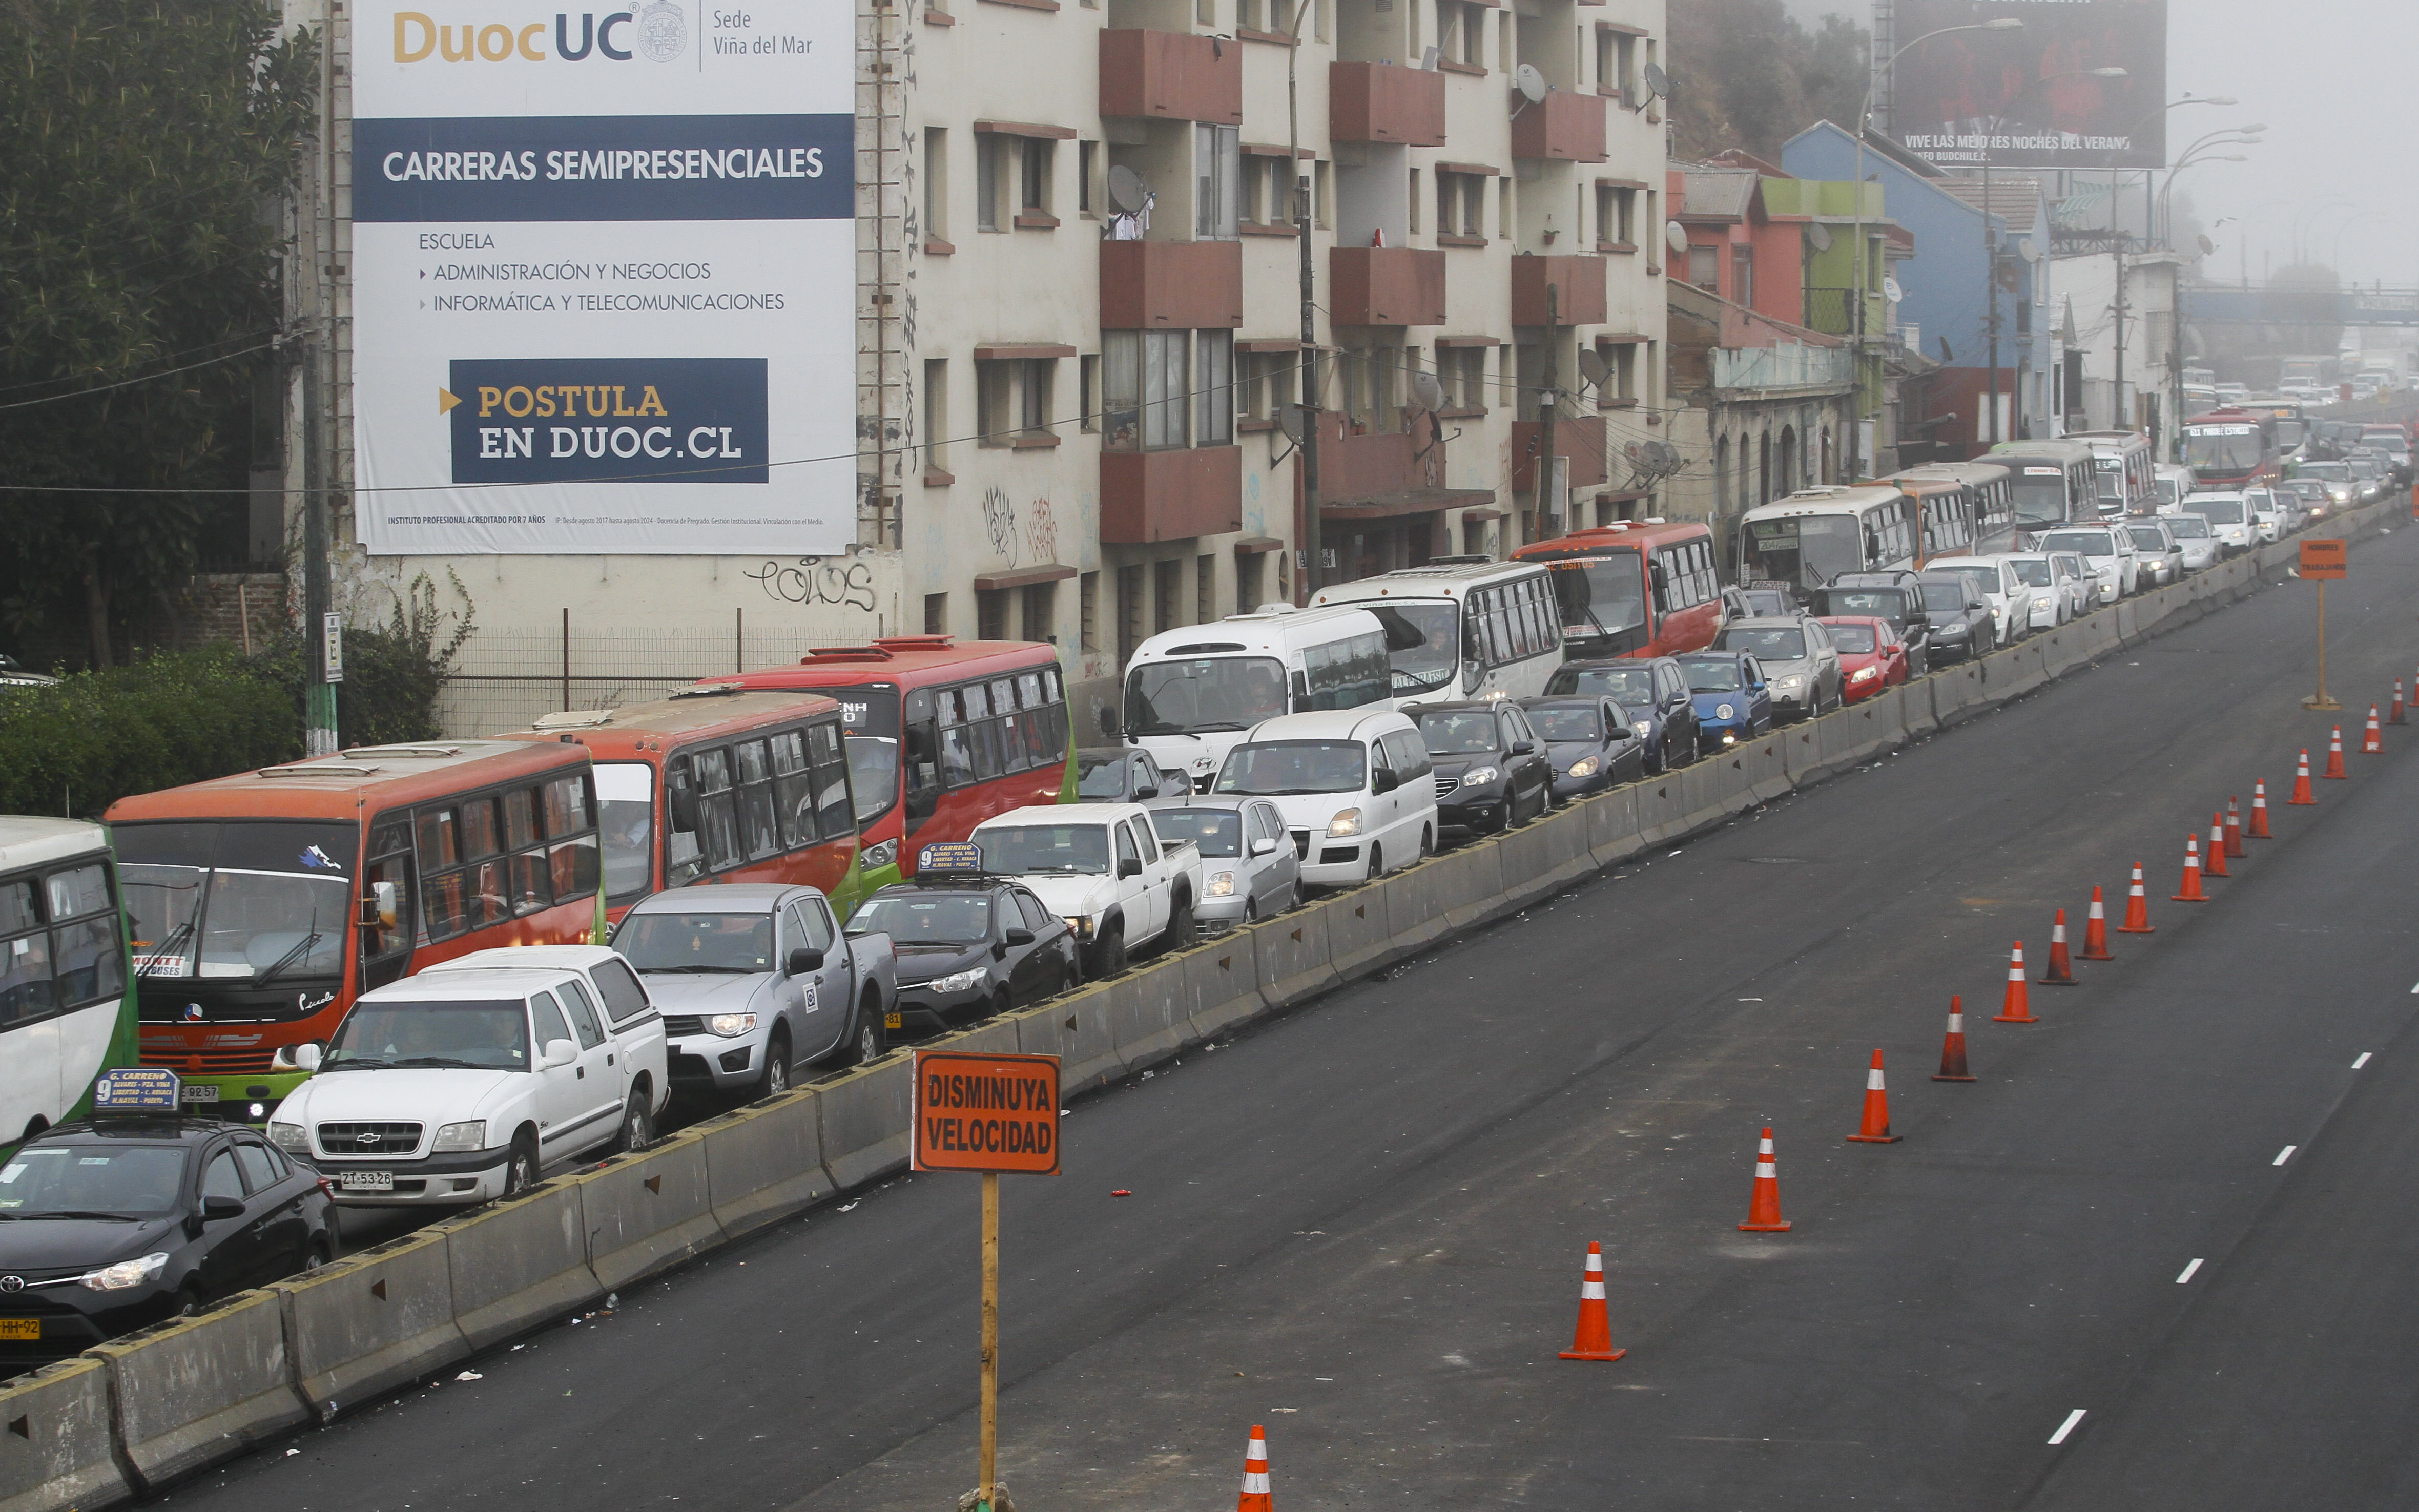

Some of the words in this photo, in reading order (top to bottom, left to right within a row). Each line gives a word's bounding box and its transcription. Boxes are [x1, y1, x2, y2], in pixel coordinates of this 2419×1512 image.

[714, 10, 751, 28] Sede
[714, 36, 747, 54] Viña
[753, 35, 776, 54] del
[782, 36, 812, 54] Mar
[1905, 135, 1931, 148] VIVE
[1933, 135, 1955, 148] LAS
[1957, 135, 2010, 149] MEJORES
[2012, 136, 2058, 149] NOCHES
[2061, 136, 2082, 149] DEL
[2084, 136, 2131, 150] VERANO
[383, 151, 536, 181] CARRERAS
[546, 148, 823, 180] SEMIPRESENCIALES
[420, 234, 495, 250] ESCUELA
[434, 260, 589, 280] ADMINISTRACIÓN
[595, 264, 607, 280] Y
[613, 263, 711, 280] NEGOCIOS
[435, 291, 555, 312] INFORMÁTICA
[562, 295, 573, 311] Y
[578, 294, 784, 311] TELECOMUNICACIONES
[479, 386, 668, 417] POSTULA
[479, 427, 534, 458] EN
[550, 426, 742, 458] DUOC.CL
[528, 515, 546, 523] AÑOS
[921, 851, 932, 866] 9
[97, 1080, 112, 1102] 9
[928, 1074, 1050, 1112] DISMINUYA
[928, 1117, 1051, 1154] VELOCIDAD
